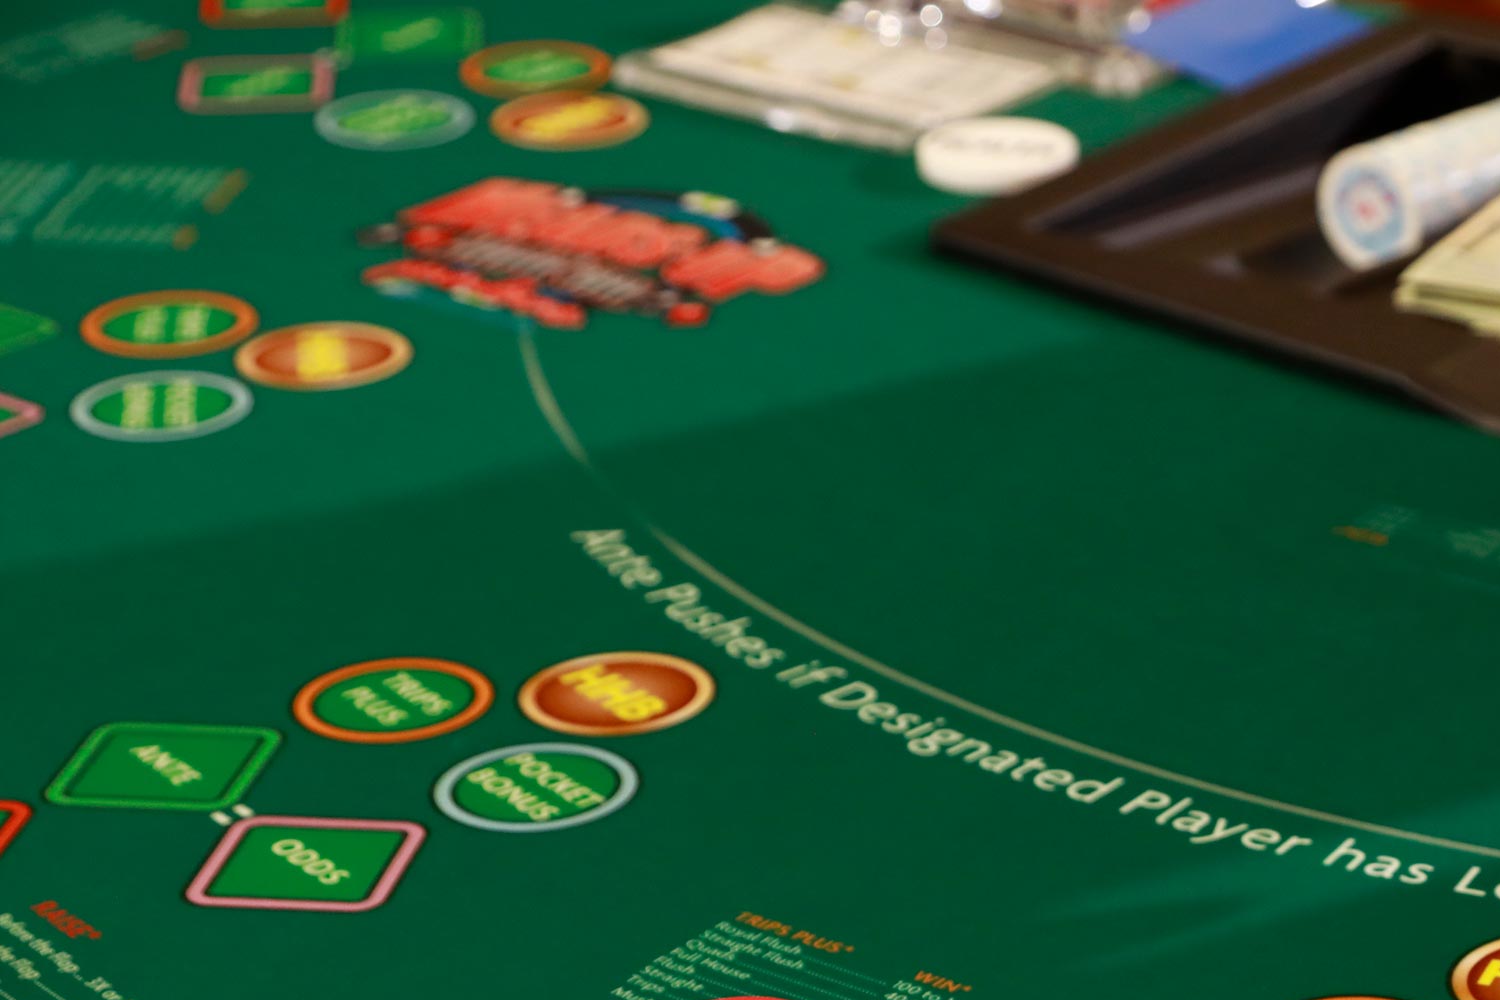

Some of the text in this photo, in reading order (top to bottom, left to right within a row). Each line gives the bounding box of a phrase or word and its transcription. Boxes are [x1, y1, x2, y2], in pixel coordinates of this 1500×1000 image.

[341, 686, 409, 726] PLUS
[382, 670, 453, 716] TRIPS
[560, 663, 668, 722] HHB
[570, 529, 662, 589] Ante
[644, 582, 785, 669] Pushes
[776, 660, 848, 689] if
[819, 681, 1125, 803] Designated
[1119, 789, 1312, 855] Player
[1323, 838, 1434, 885] has
[129, 744, 202, 786] ANTE
[503, 752, 607, 808] POCKET
[467, 767, 560, 822] BONUS
[271, 838, 350, 885] ODDS
[735, 911, 792, 937] TRIPS
